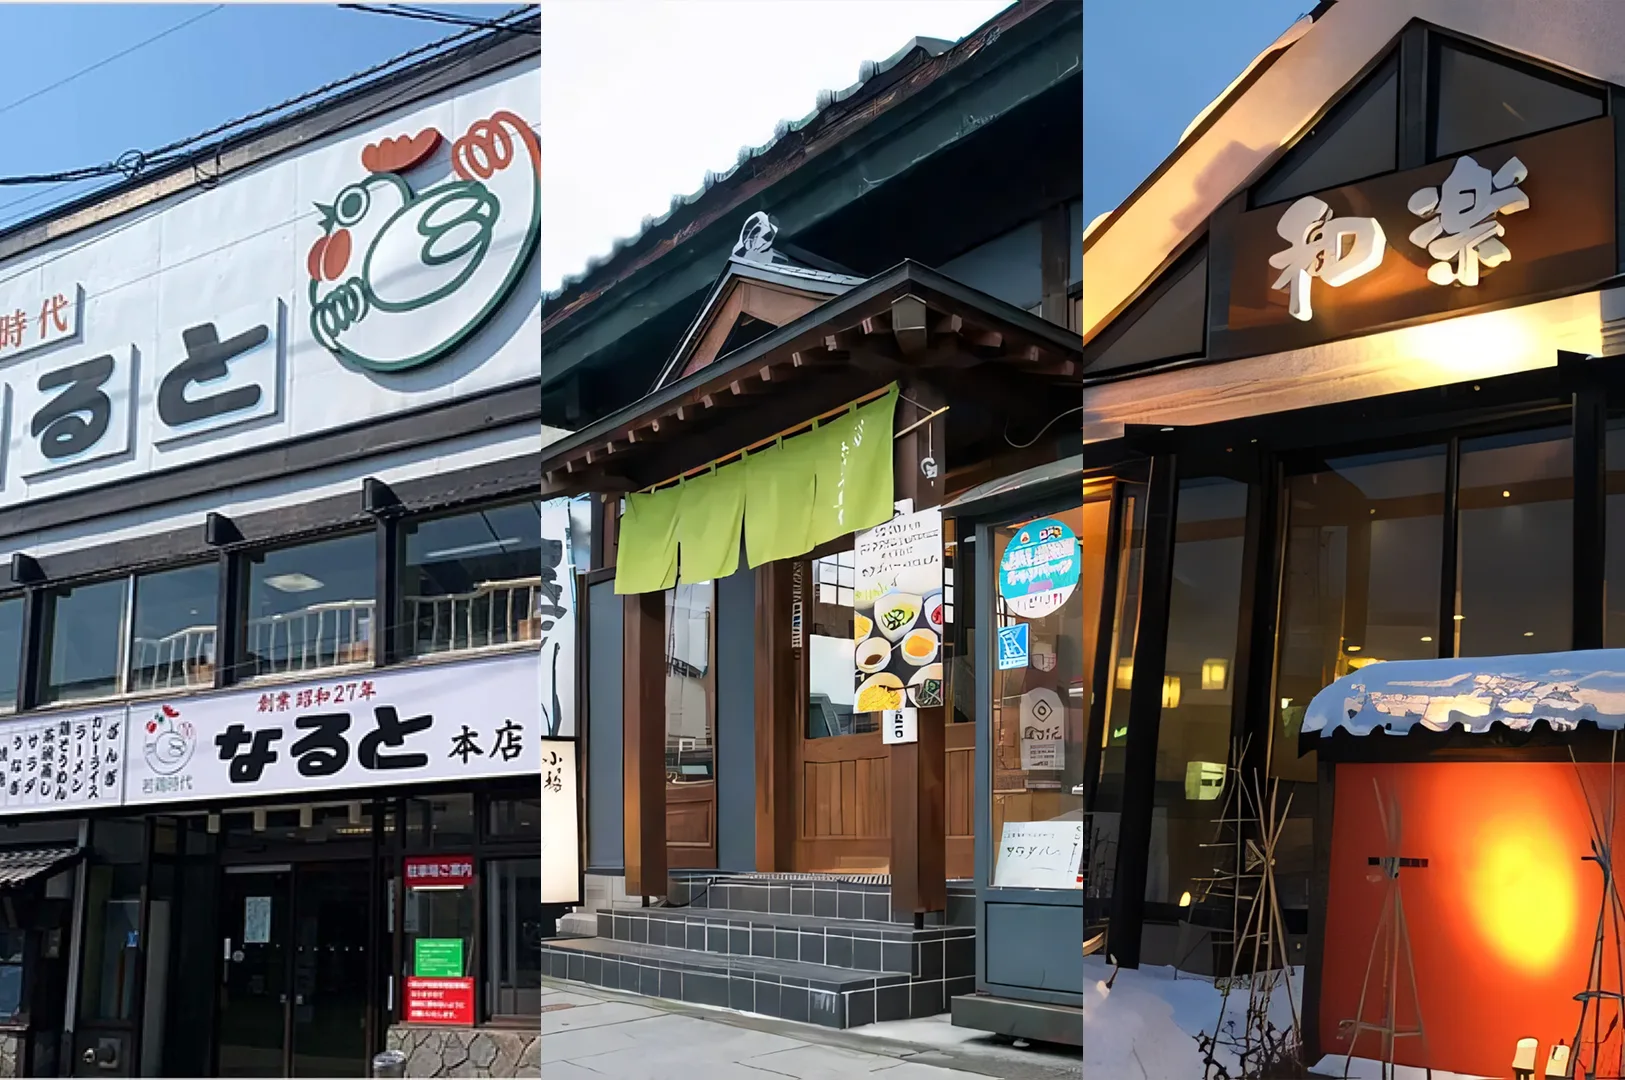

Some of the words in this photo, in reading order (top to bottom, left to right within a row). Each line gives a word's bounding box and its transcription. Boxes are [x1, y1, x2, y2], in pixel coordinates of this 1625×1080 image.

[1268, 155, 1530, 321] 和楽
[31, 322, 269, 459] ると
[24, 734, 38, 794] サラダ
[72, 725, 86, 793] ラーメン
[88, 716, 102, 799] カレーライス
[214, 706, 434, 783] なると
[448, 720, 525, 765] 本店
